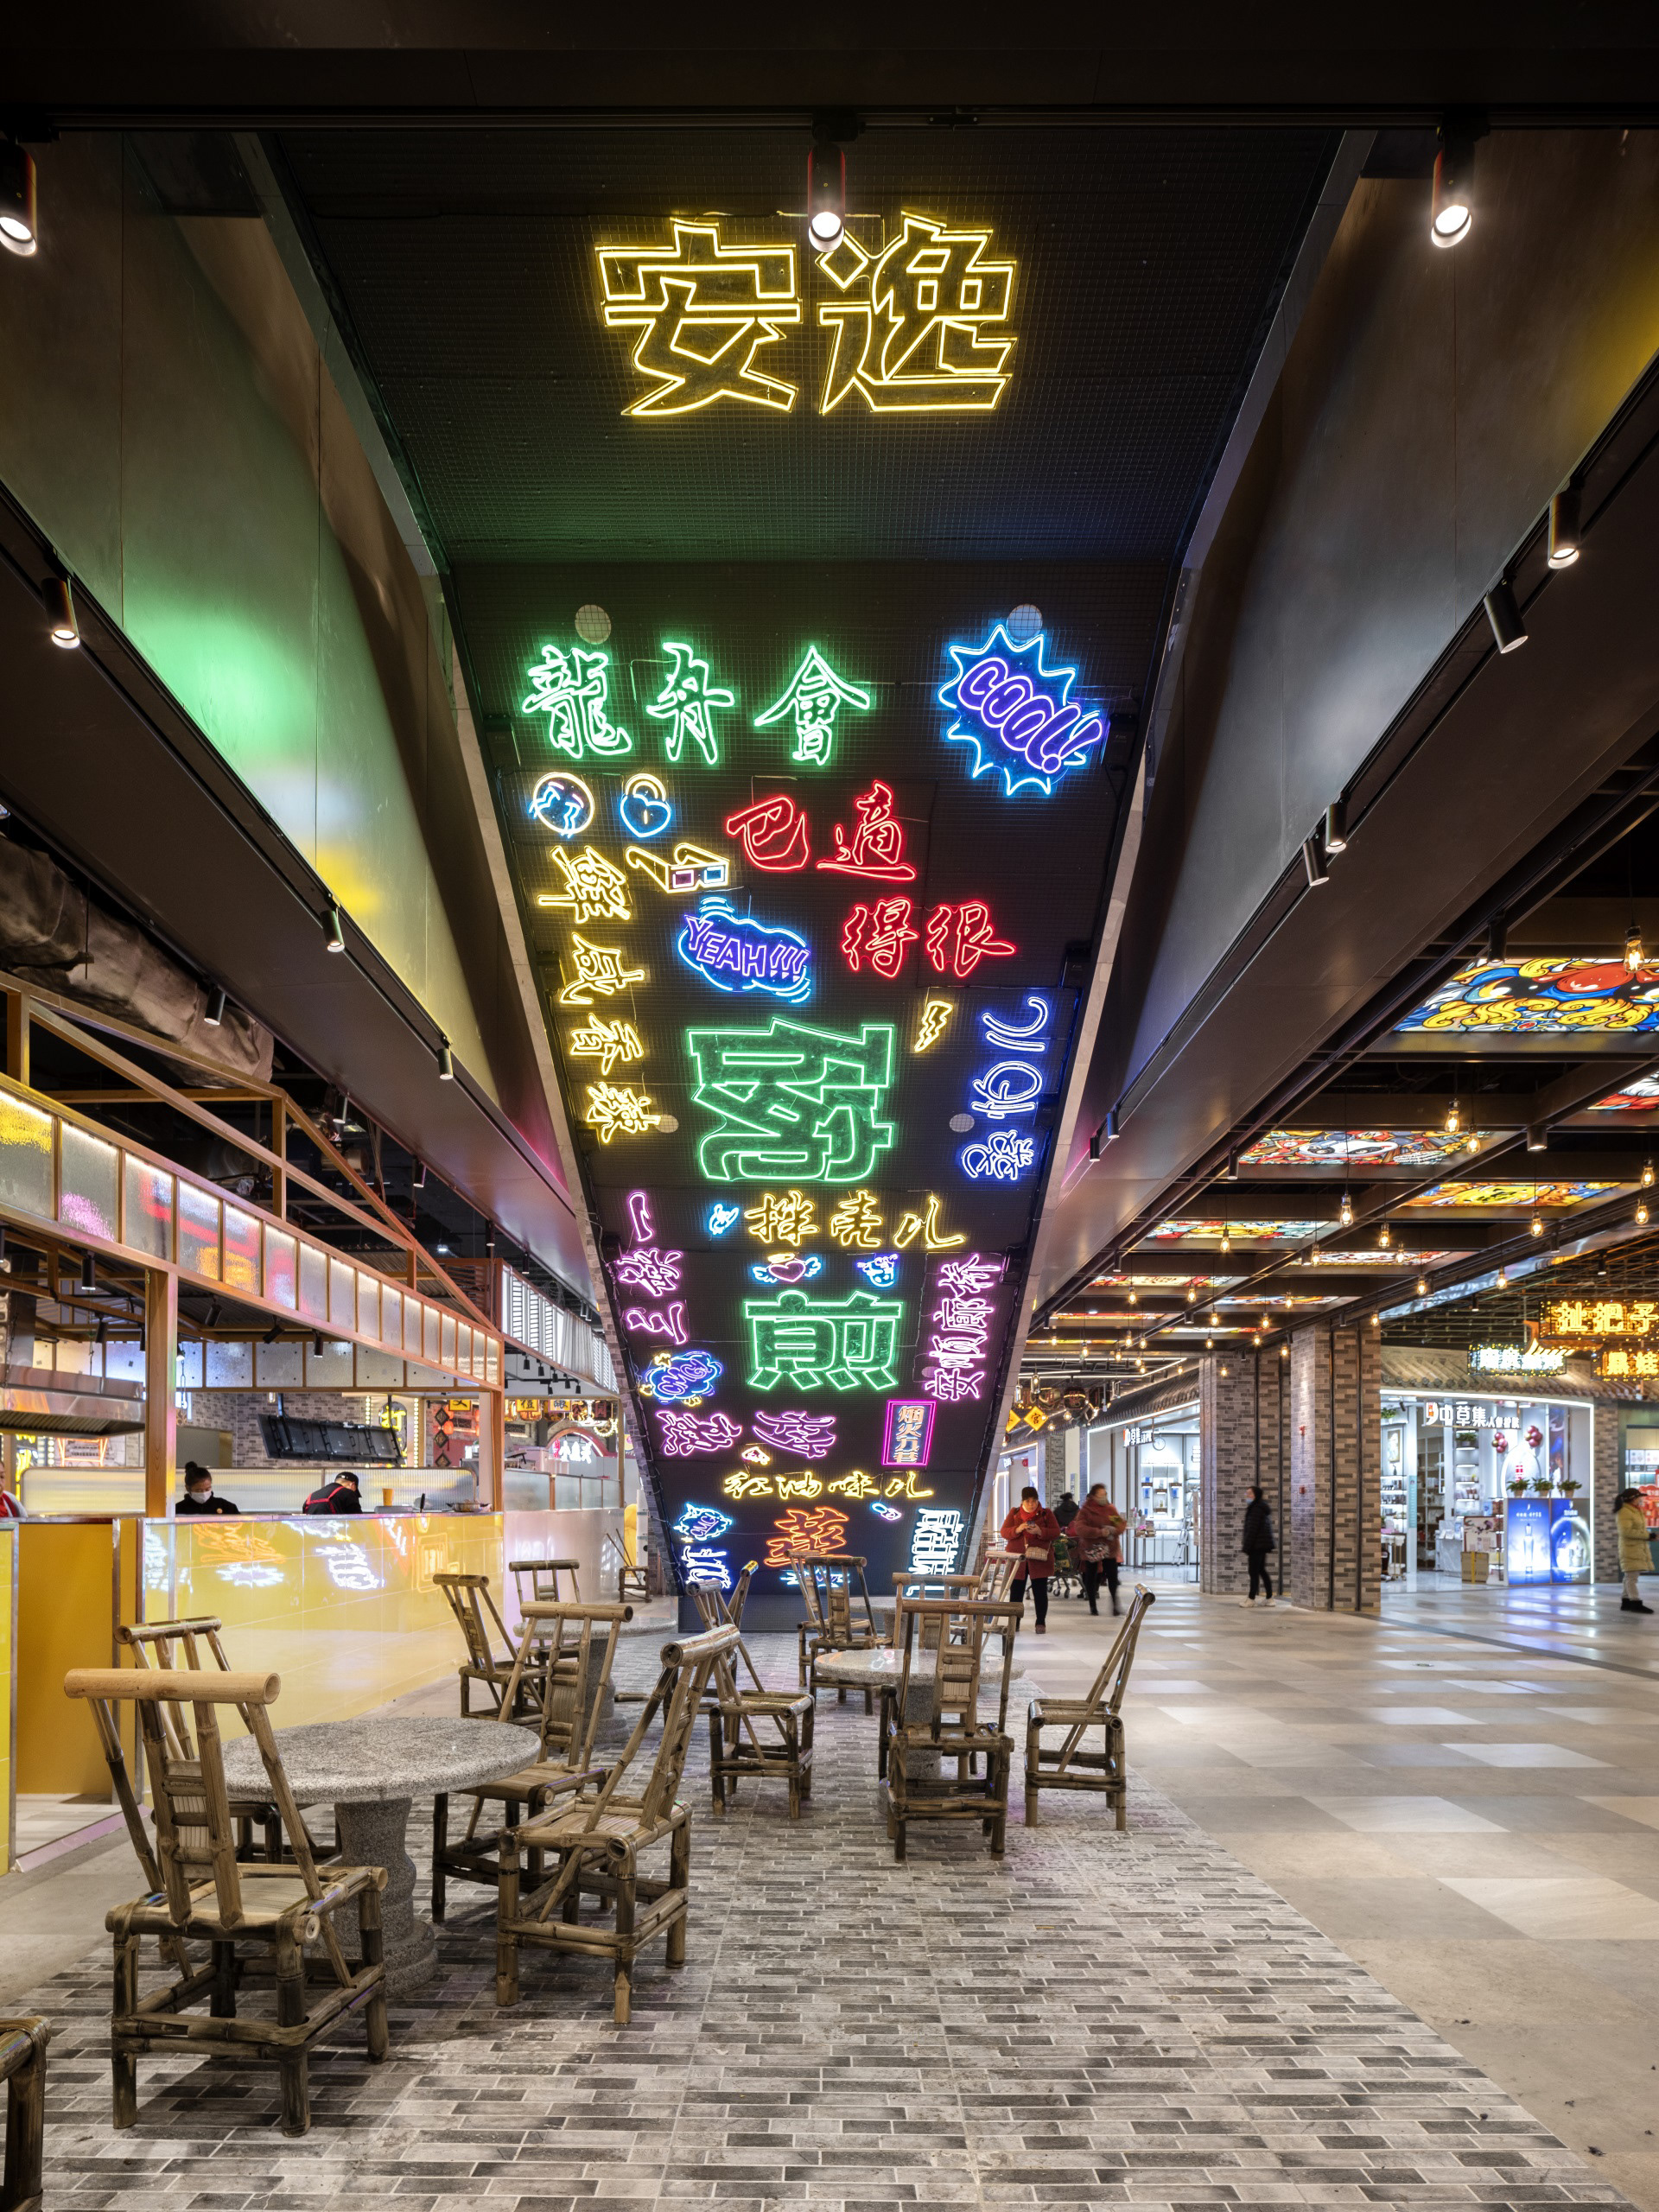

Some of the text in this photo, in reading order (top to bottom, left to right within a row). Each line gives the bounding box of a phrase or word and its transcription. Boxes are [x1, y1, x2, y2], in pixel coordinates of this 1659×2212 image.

[594, 211, 1018, 416] 安逸
[684, 914, 810, 983] YEAH!!!
[840, 896, 1016, 978] 得很
[742, 1291, 903, 1391] 煎
